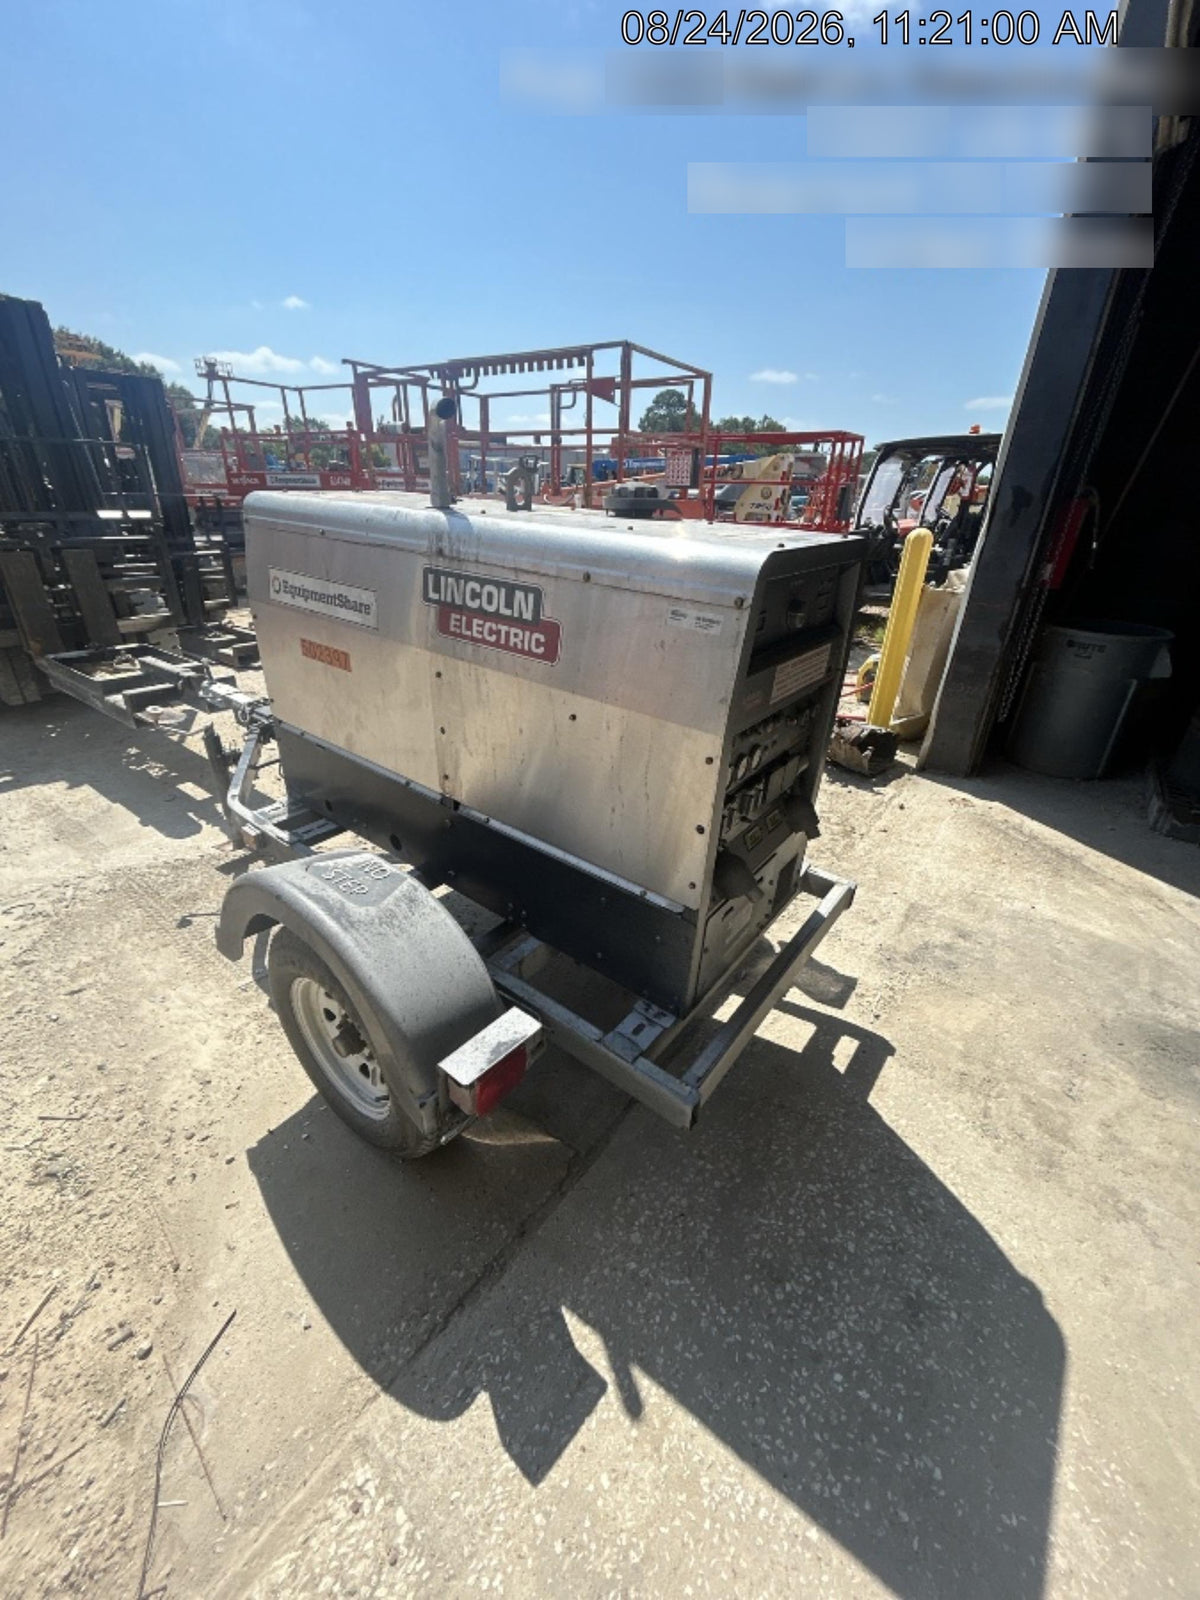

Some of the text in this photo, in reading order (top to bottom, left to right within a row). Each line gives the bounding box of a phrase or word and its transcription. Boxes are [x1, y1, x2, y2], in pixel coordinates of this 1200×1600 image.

[282, 580, 371, 615] EquipmentShare
[427, 574, 534, 621] LINCOLN
[450, 613, 545, 654] ELECTRIC
[321, 869, 368, 894] STEP
[359, 860, 390, 879] NO
